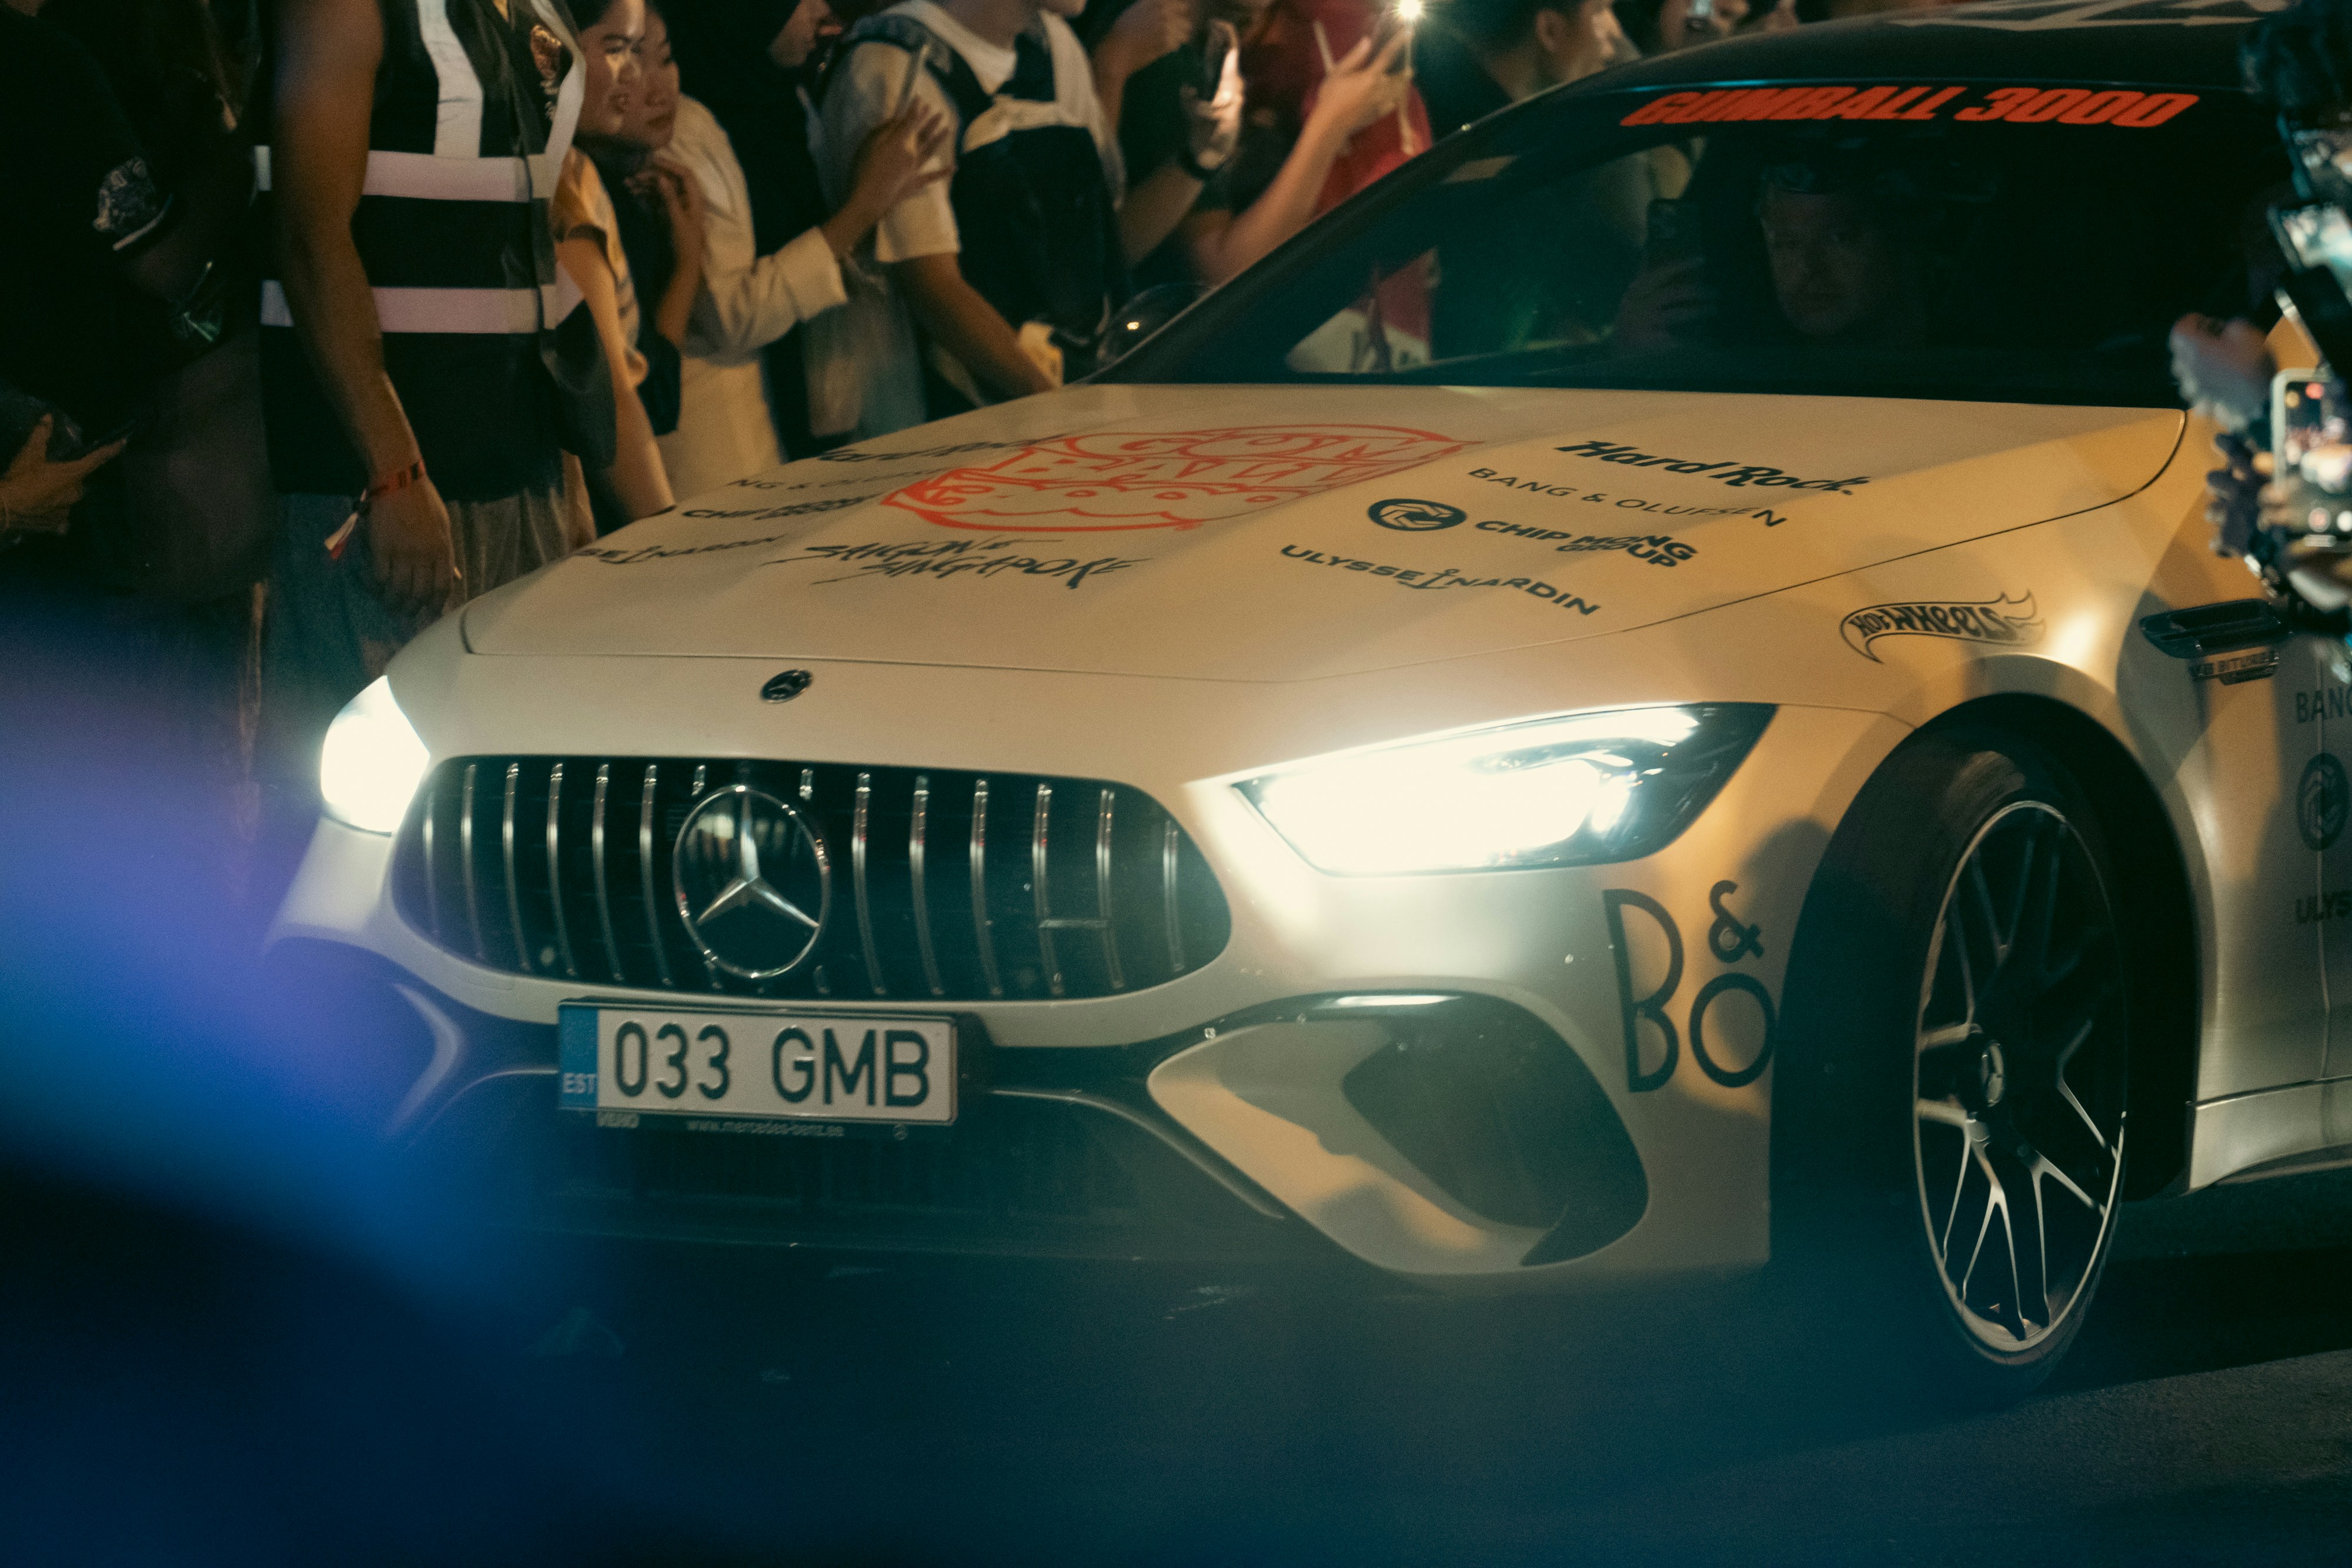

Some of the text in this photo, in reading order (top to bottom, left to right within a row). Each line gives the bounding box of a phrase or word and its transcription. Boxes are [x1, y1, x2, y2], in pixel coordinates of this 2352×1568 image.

[1619, 86, 2200, 128] GUMBALL 3000
[1554, 440, 1740, 474] Hard
[1469, 467, 1788, 527] BANG & OLUFSEN
[1475, 520, 1698, 561] CHIP MONG
[1556, 542, 1678, 569] GROUP
[1280, 544, 1601, 616] ULYSSE NARDIN
[1848, 608, 1892, 638] HOT
[562, 1072, 598, 1094] EST
[614, 1021, 930, 1107] 033 GMB
